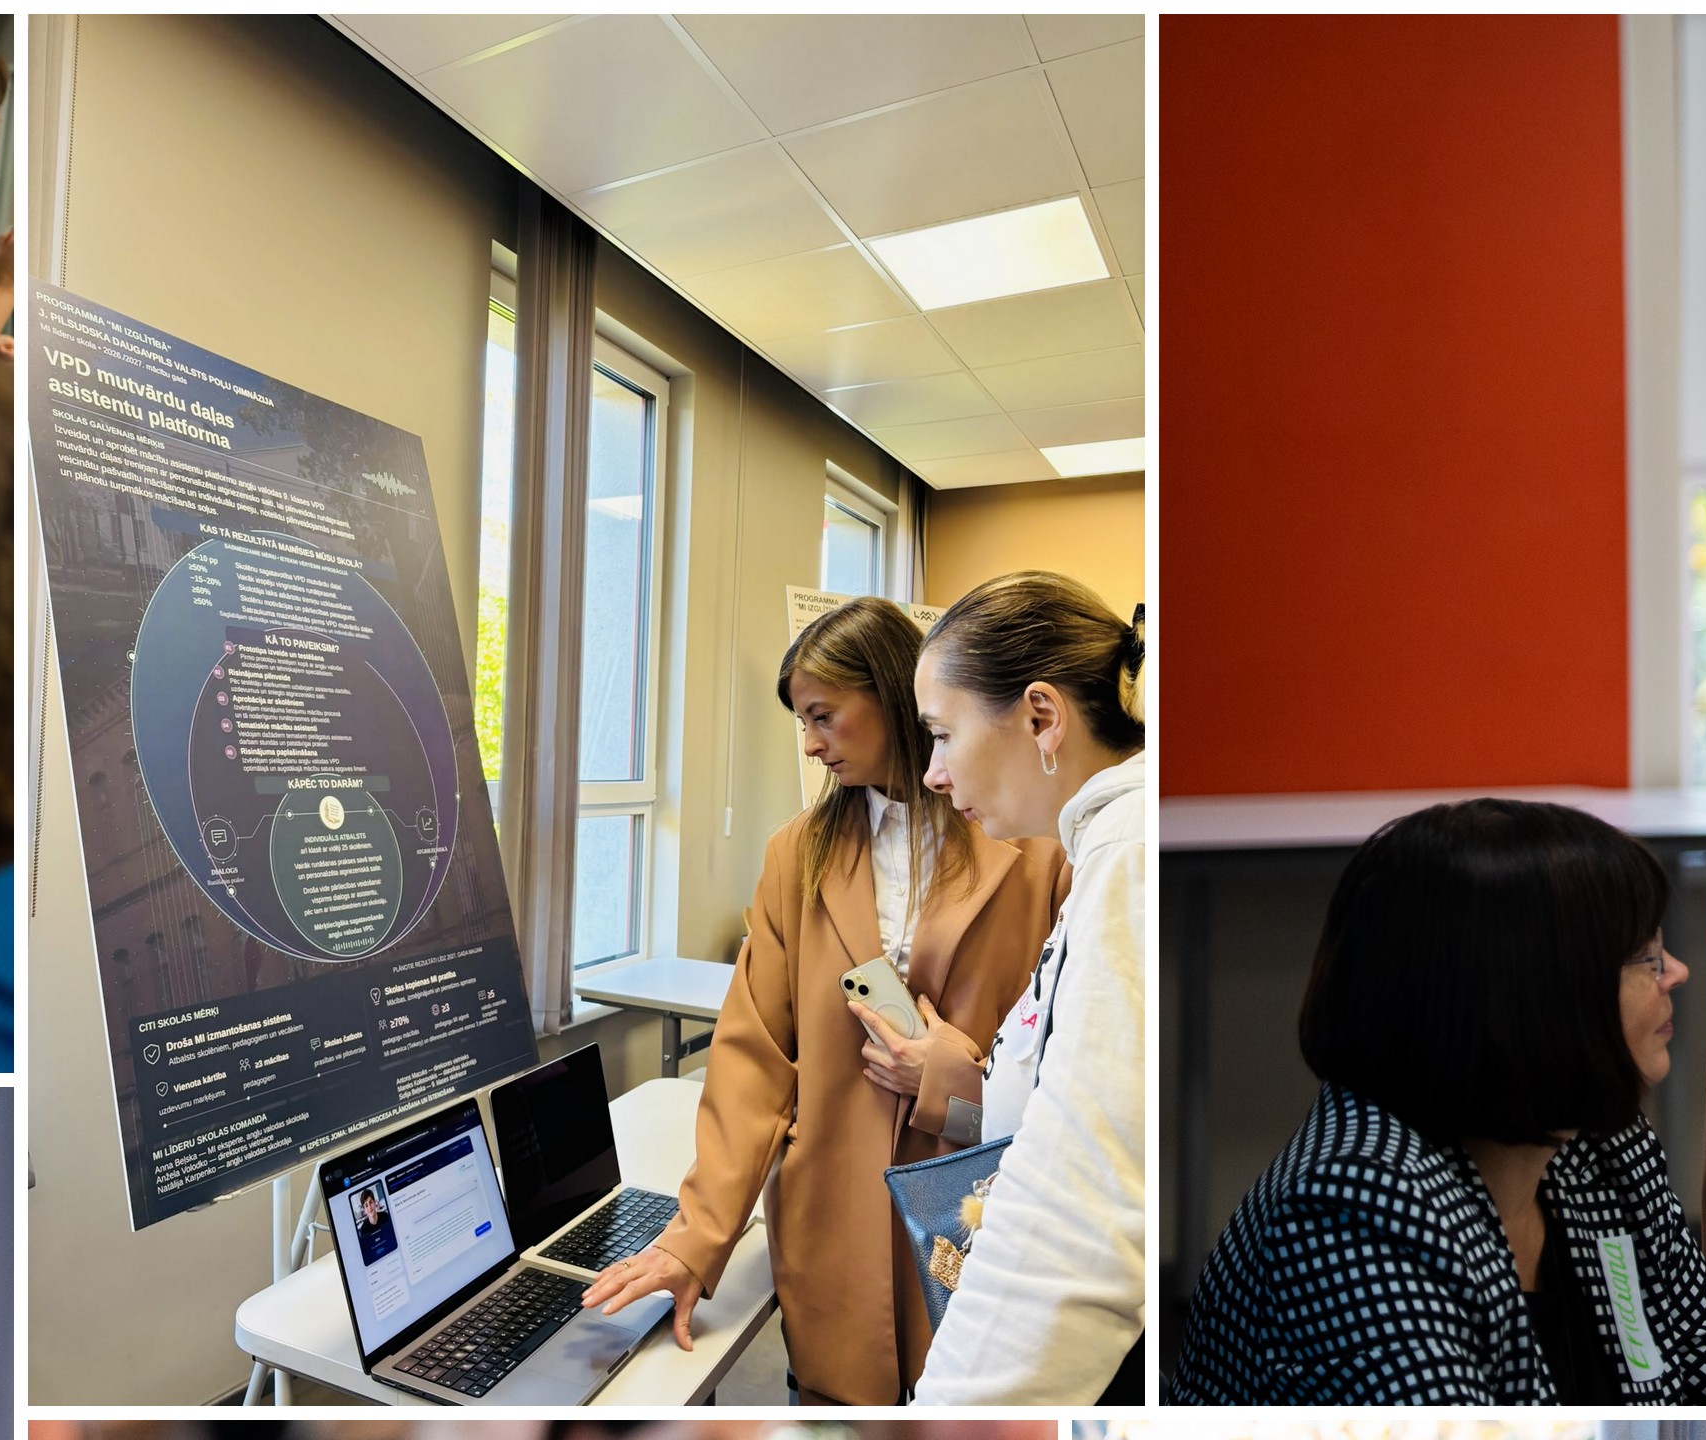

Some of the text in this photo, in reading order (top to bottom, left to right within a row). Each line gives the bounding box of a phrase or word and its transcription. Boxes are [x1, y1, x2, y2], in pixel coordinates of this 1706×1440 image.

[36, 291, 104, 326] PROGRAMMA
[107, 320, 122, 334] "MI
[38, 309, 274, 408] J. PILSUDSKA DAUGAVPILS VALSTS POĻU ĢIMNĀZIJA
[41, 323, 50, 332] MI
[53, 326, 74, 342] līderu
[77, 336, 96, 350] skola
[146, 363, 169, 379] mācību
[172, 373, 187, 385] gads
[44, 346, 234, 429] VPD mutvārdu daļas
[49, 376, 231, 449] asistentu platforma
[52, 409, 165, 450] SKOLAS GALVENAIS MĒRĶIS
[200, 523, 217, 536] KAS
[219, 525, 230, 539] TĀ
[233, 530, 277, 550] REZULTĀTĀ
[279, 540, 315, 559] MAINĪSIES
[316, 547, 336, 563] MŪSU
[338, 554, 363, 569] SKOLĀ?
[794, 593, 838, 605] PROGRAMMA
[265, 633, 339, 654] KĀ TO PAVEIKSIM?
[288, 777, 363, 790] KĀPĒC TO DARĀM?
[139, 1007, 219, 1033] CITI SKOLAS MĒRĶI
[166, 1012, 292, 1052] Droša MI izmantošanas sistēma
